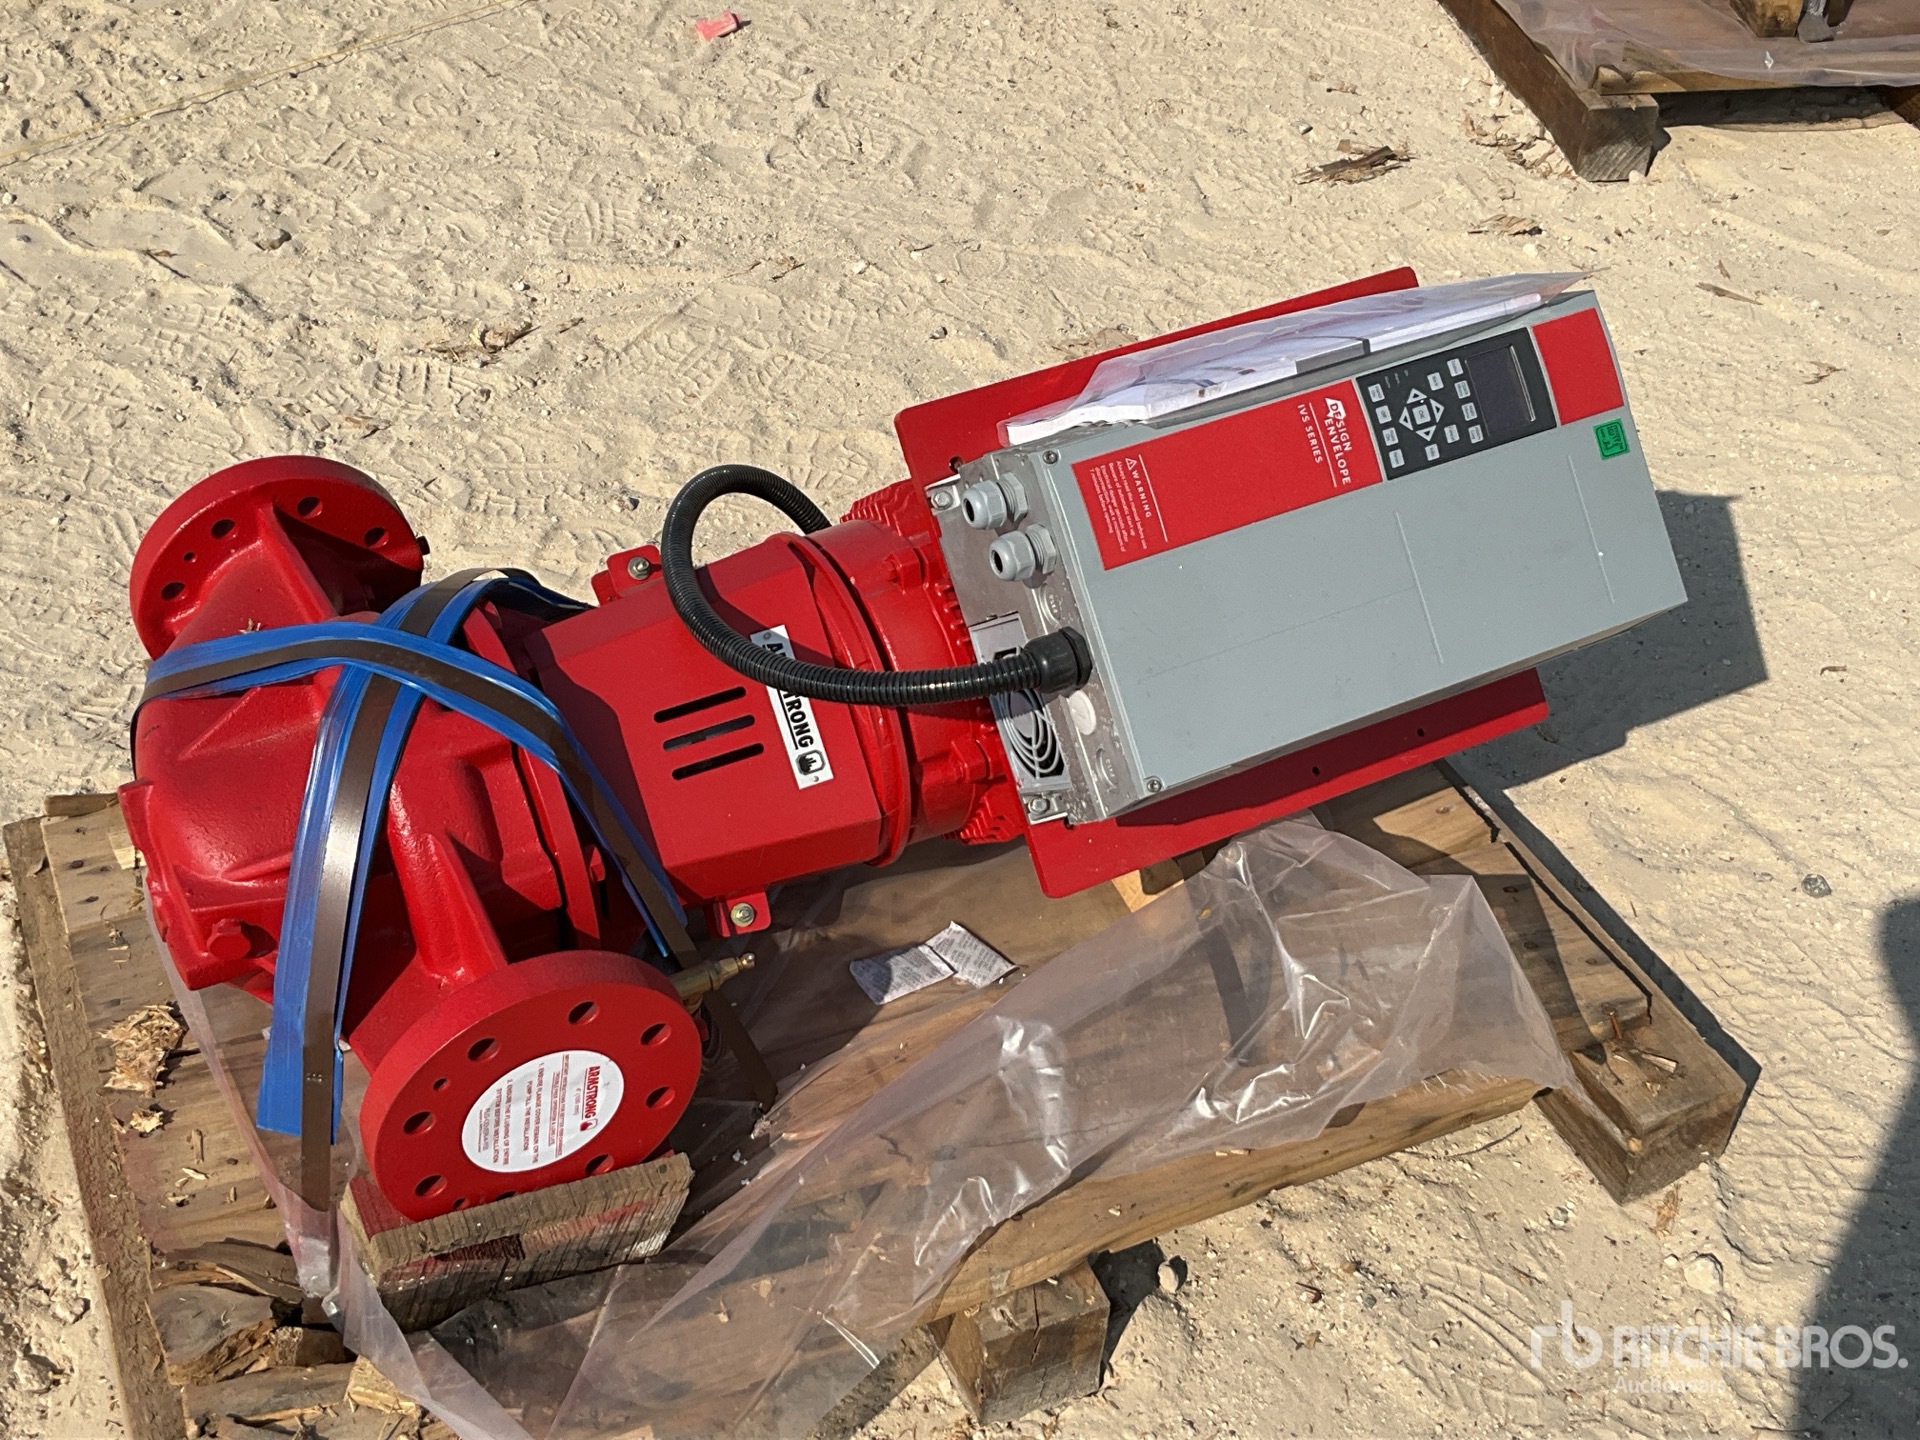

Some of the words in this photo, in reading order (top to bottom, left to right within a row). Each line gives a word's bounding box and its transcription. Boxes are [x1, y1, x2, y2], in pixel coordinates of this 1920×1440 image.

[1297, 404, 1310, 423] IVS
[1305, 426, 1323, 464] SERIES
[1330, 402, 1352, 451] DESIGN
[1417, 409, 1426, 420] OK
[1325, 419, 1351, 485] ENVELOPE
[1098, 494, 1108, 512] before
[1100, 465, 1112, 489] Electrical
[1121, 529, 1129, 542] after
[1107, 504, 1115, 516] wait
[1116, 460, 1126, 480] Always
[1136, 522, 1145, 539] before
[1117, 488, 1129, 515] automatic
[1126, 515, 1134, 528] start
[1131, 469, 1152, 519] WARNING
[766, 641, 814, 748] ATRONG
[584, 1066, 601, 1119] ARMSTRONG
